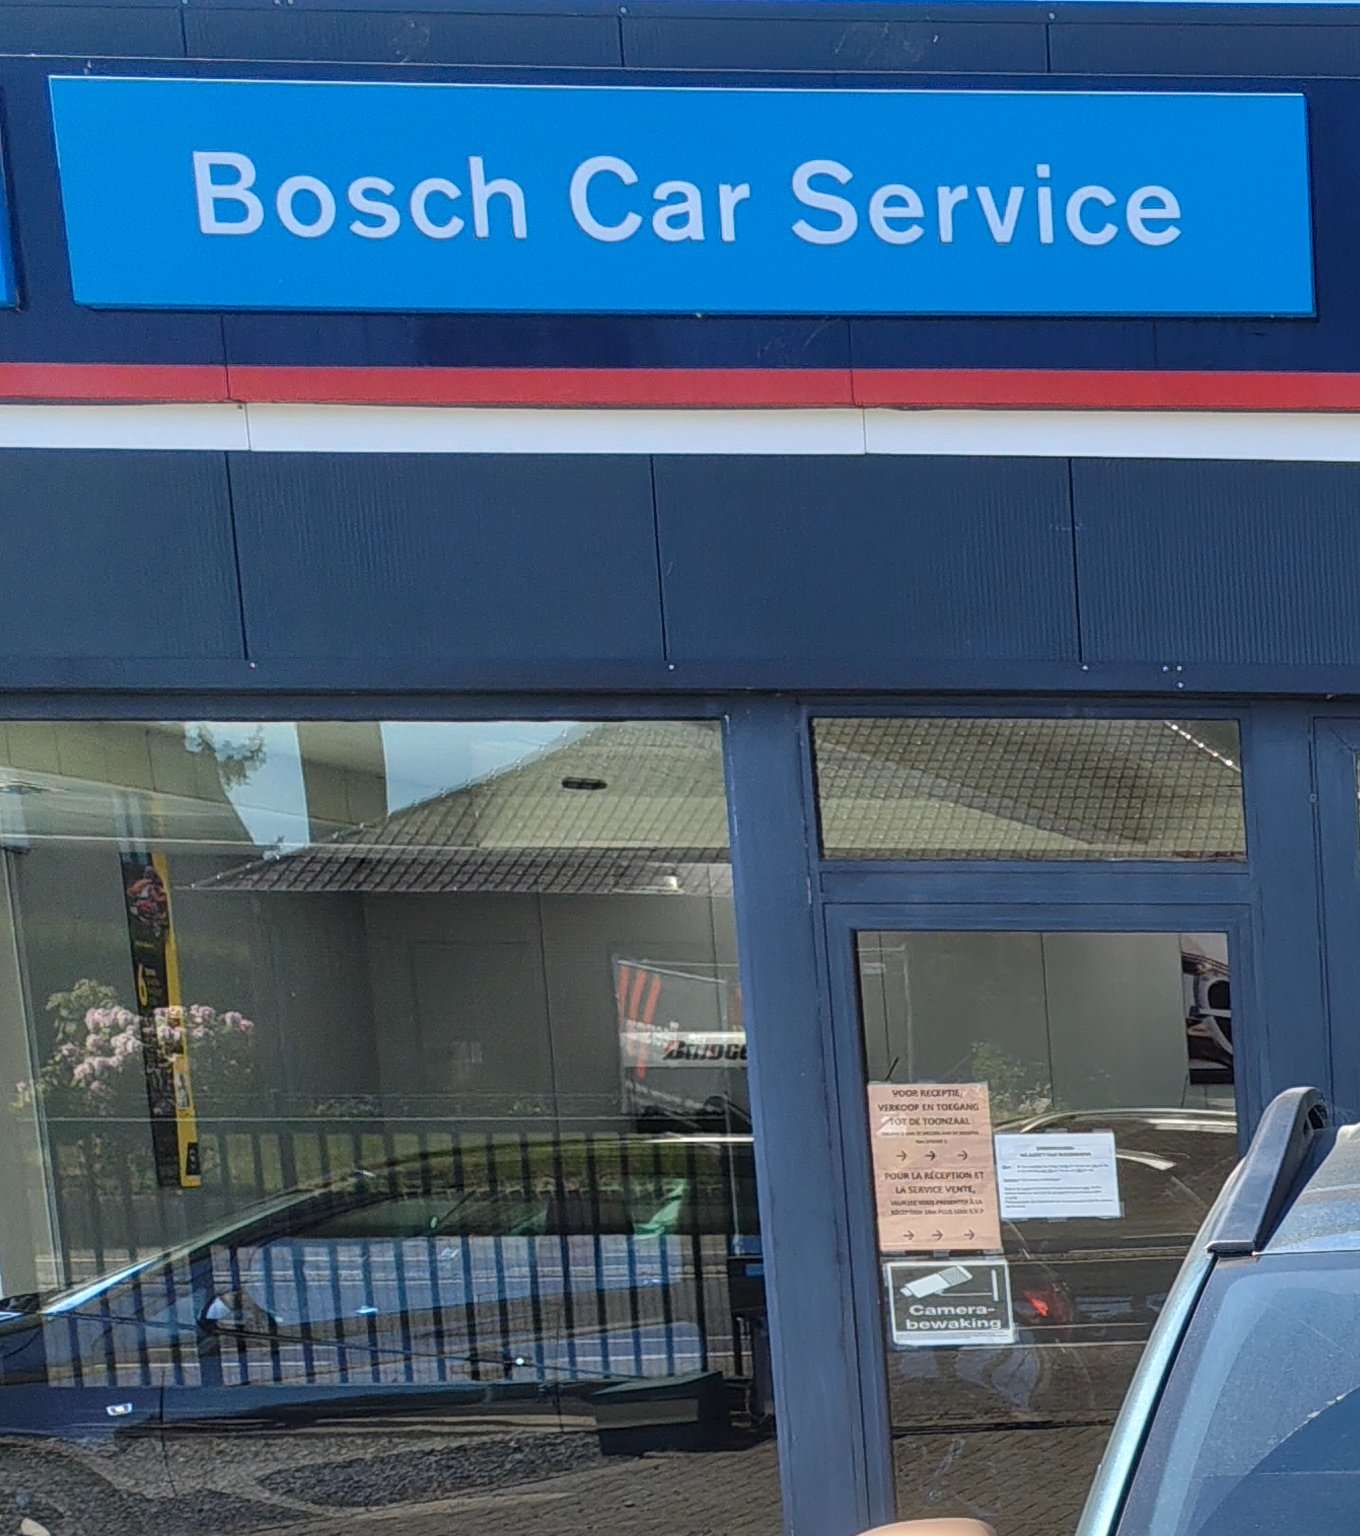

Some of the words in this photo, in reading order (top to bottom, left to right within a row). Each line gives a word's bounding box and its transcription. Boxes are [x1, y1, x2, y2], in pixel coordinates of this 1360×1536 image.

[193, 152, 526, 238] Bosch
[571, 157, 749, 241] Car
[793, 160, 1182, 245] Service
[877, 1103, 919, 1112] VERKOOP
[922, 1104, 934, 1112] EN
[937, 1103, 979, 1112] TOEGANG
[889, 1118, 906, 1126] TOT
[909, 1118, 921, 1126] DE
[923, 1117, 970, 1126] TOONZAAL
[884, 1172, 909, 1180] POUR
[911, 1172, 922, 1180] LA
[974, 1171, 984, 1180] ET
[895, 1186, 906, 1194] LA
[908, 1186, 942, 1194] SERVICE
[909, 1304, 996, 1316] Camera-
[905, 1317, 1002, 1330] bewaking
